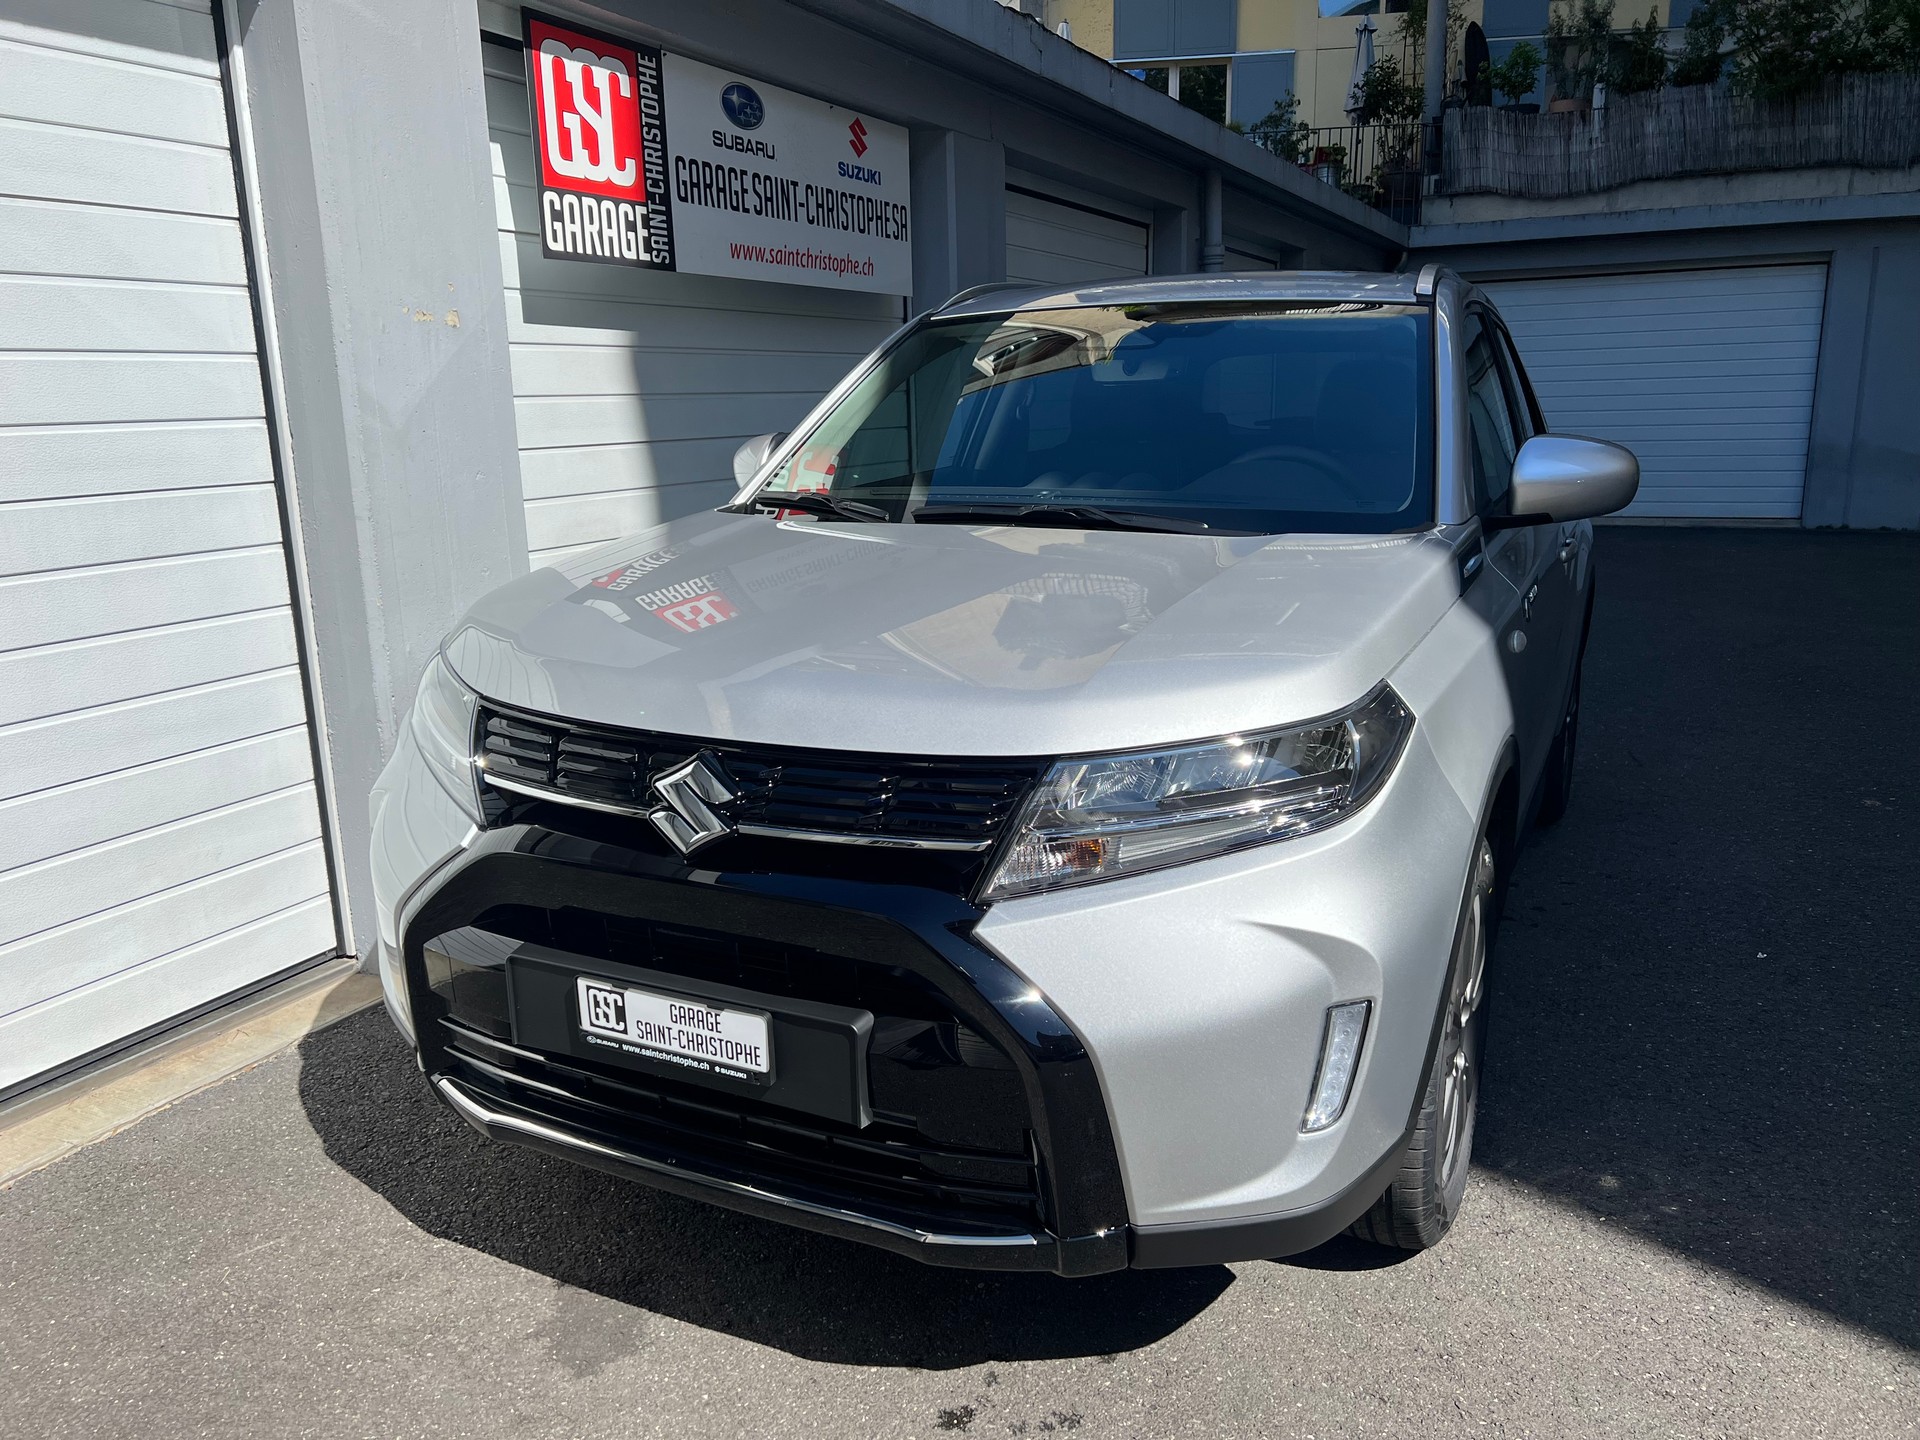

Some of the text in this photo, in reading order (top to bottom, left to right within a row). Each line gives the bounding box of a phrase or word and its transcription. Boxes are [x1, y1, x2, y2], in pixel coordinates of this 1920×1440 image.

[637, 52, 670, 265] SAINT-CHRISTOPHE
[712, 129, 776, 160] SUBARU
[838, 161, 882, 186] SUZUKI
[674, 154, 750, 215] GARAGE
[751, 171, 891, 239] SAINT-CHRISTOPHE
[542, 190, 652, 262] GARAGE
[729, 242, 875, 278] www.saintchristophe.ch
[669, 1003, 722, 1034] GARAGE
[596, 1038, 747, 1080] SUBARU www.saintchristophe.ch SUZUKI
[636, 1020, 762, 1067] SAINT-CHRISTOPHE
